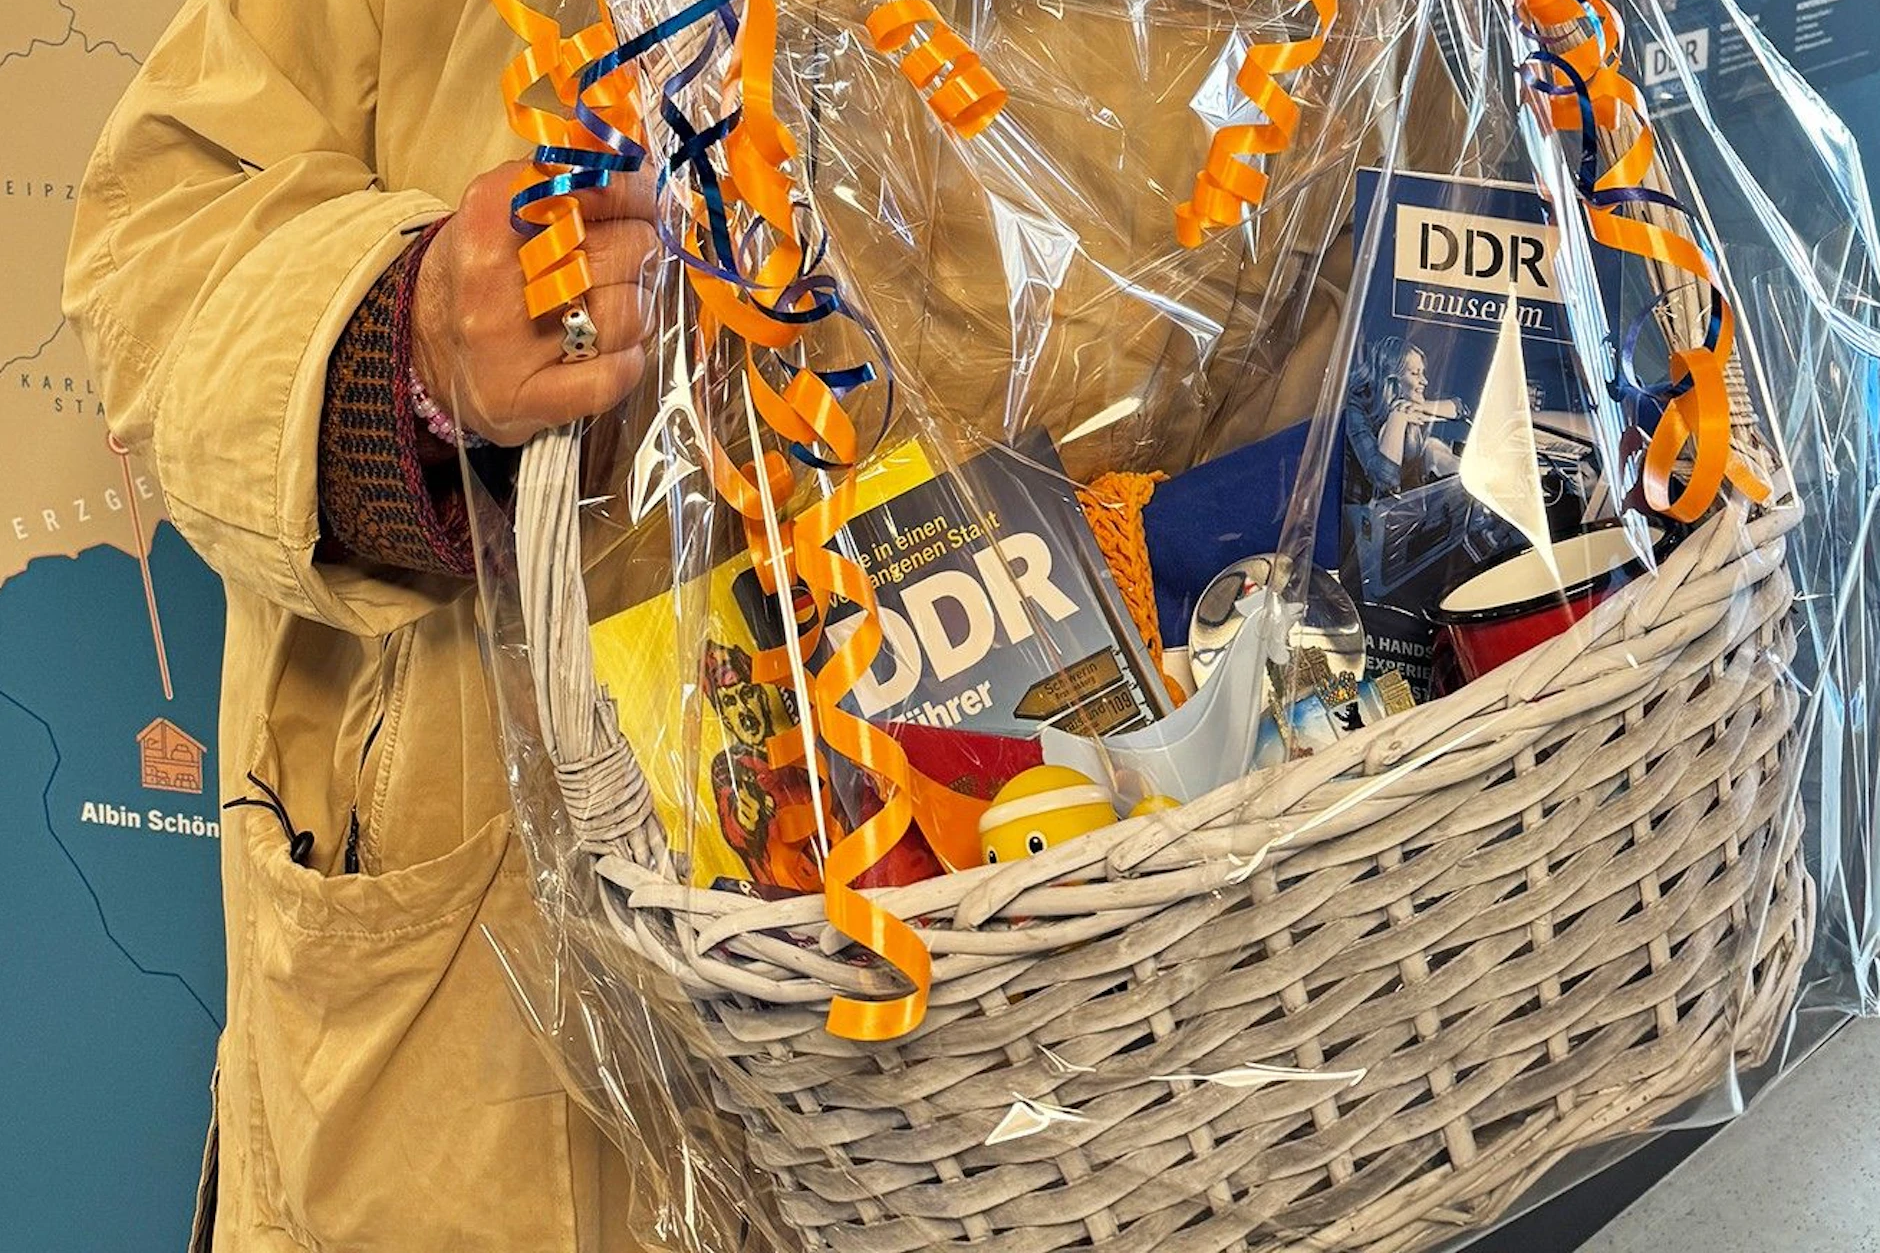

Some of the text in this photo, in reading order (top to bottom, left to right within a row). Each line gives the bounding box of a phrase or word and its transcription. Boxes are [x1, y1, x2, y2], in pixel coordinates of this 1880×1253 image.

[1653, 39, 1700, 76] DR
[6, 180, 75, 200] EIPZ
[1420, 222, 1549, 288] DDR
[55, 397, 106, 416] STA
[12, 475, 154, 540] ERZGE
[873, 542, 893, 564] in
[896, 515, 948, 552] einen
[824, 531, 1080, 719] DDR
[1366, 634, 1434, 659] A HANDS
[1367, 656, 1431, 680] EXPERIE
[1108, 690, 1132, 715] 109
[81, 801, 220, 838] Albin Schön
